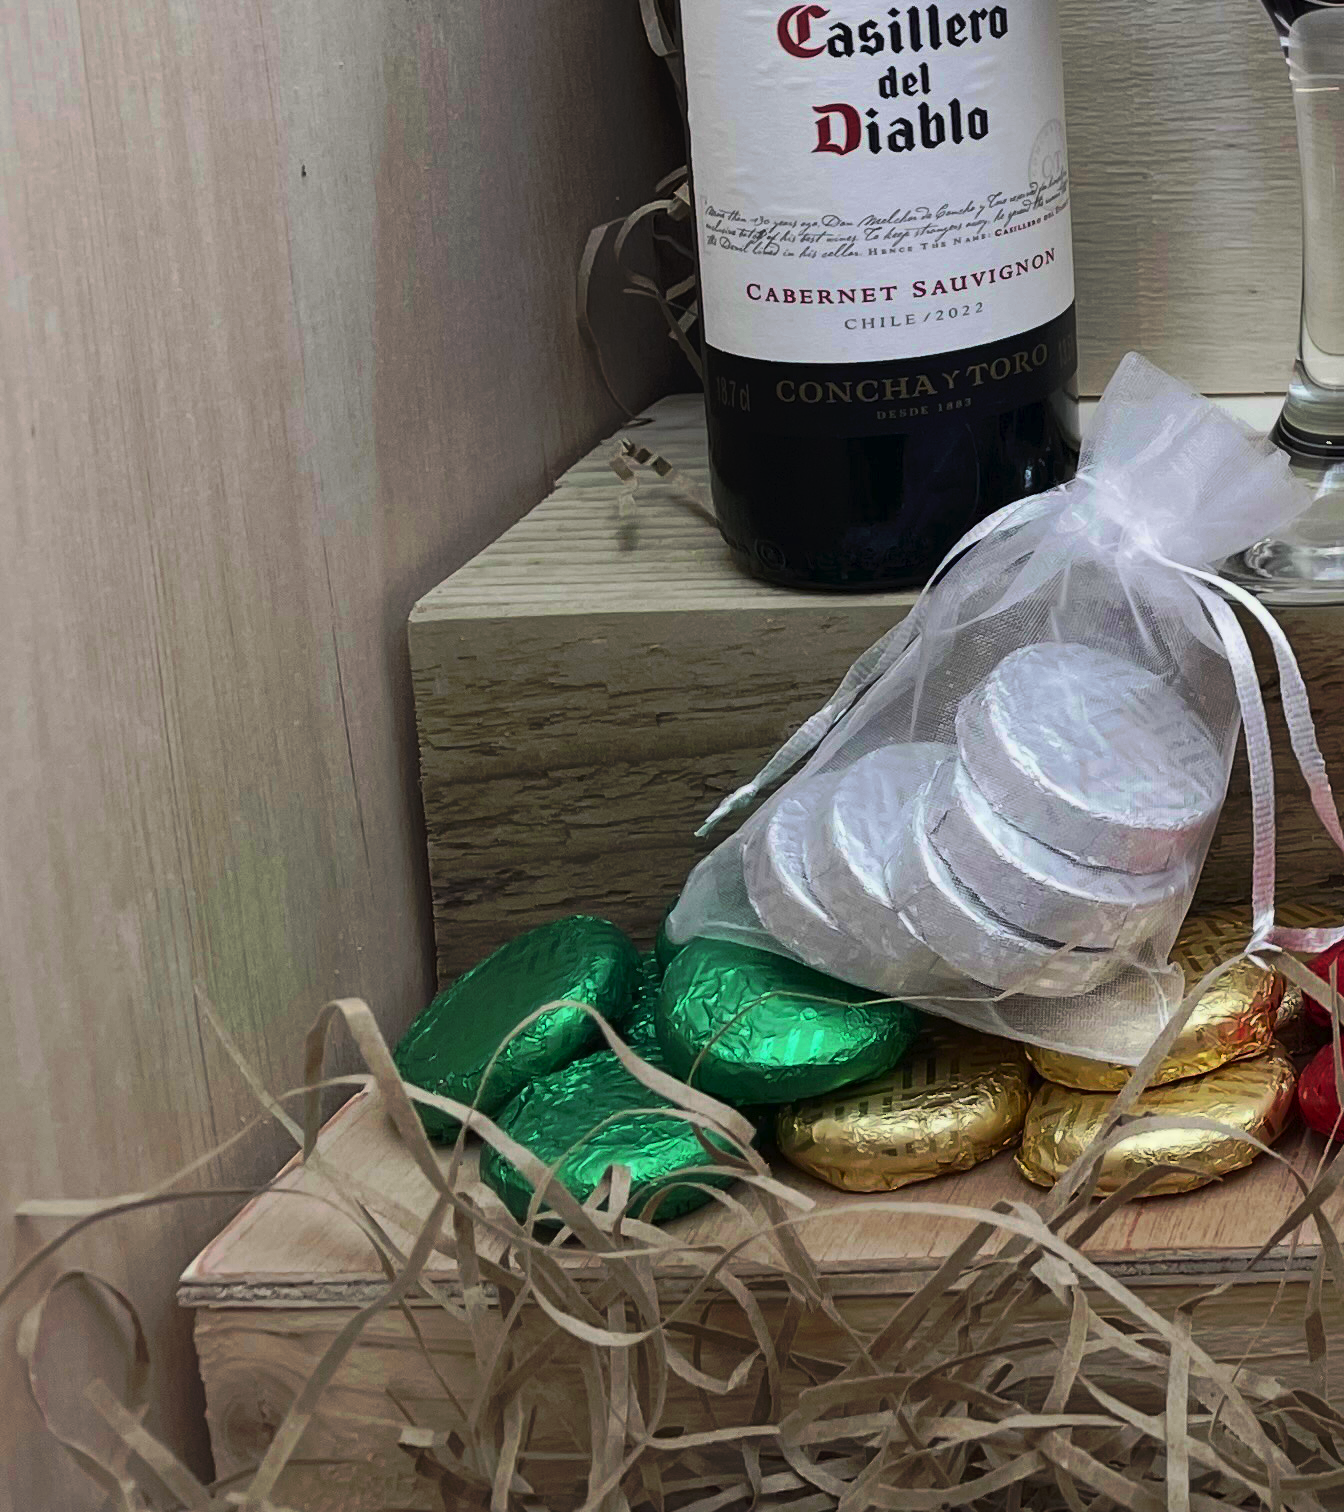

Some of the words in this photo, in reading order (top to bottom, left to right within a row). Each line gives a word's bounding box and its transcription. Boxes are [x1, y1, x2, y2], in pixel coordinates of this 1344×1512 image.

[777, 3, 1009, 59] Casillero
[877, 62, 932, 100] del
[811, 97, 990, 156] Diablo
[746, 282, 898, 305] CABERNET
[912, 247, 1057, 299] SAUVIGNON
[775, 374, 938, 404] CONCHA
[942, 369, 961, 389] Y
[965, 342, 1048, 388] TORO
[876, 404, 930, 421] DESDE
